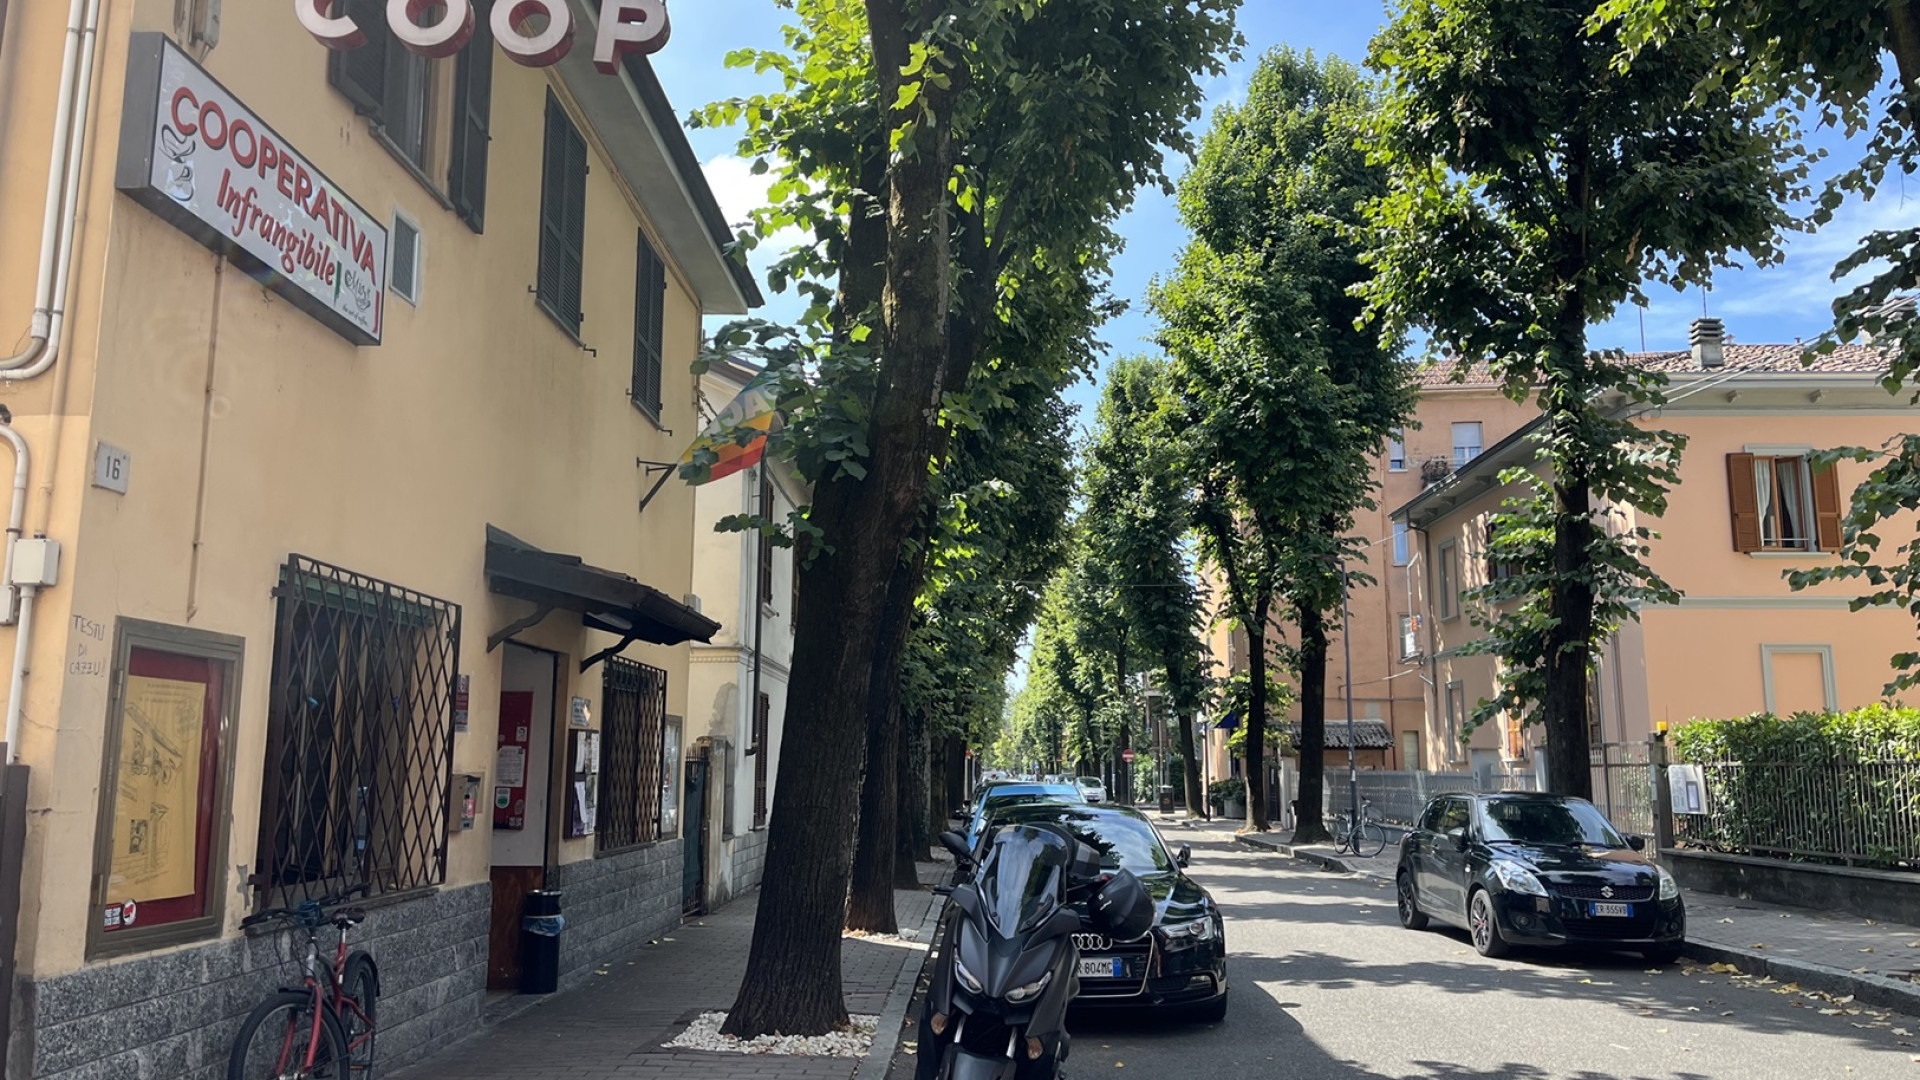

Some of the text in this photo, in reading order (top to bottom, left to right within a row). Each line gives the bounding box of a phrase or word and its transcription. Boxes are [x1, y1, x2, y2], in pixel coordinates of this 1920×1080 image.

[294, 0, 671, 75] COOP
[171, 86, 377, 286] COOPERATIVA
[216, 167, 336, 287] Infrangibile
[105, 455, 121, 480] 16
